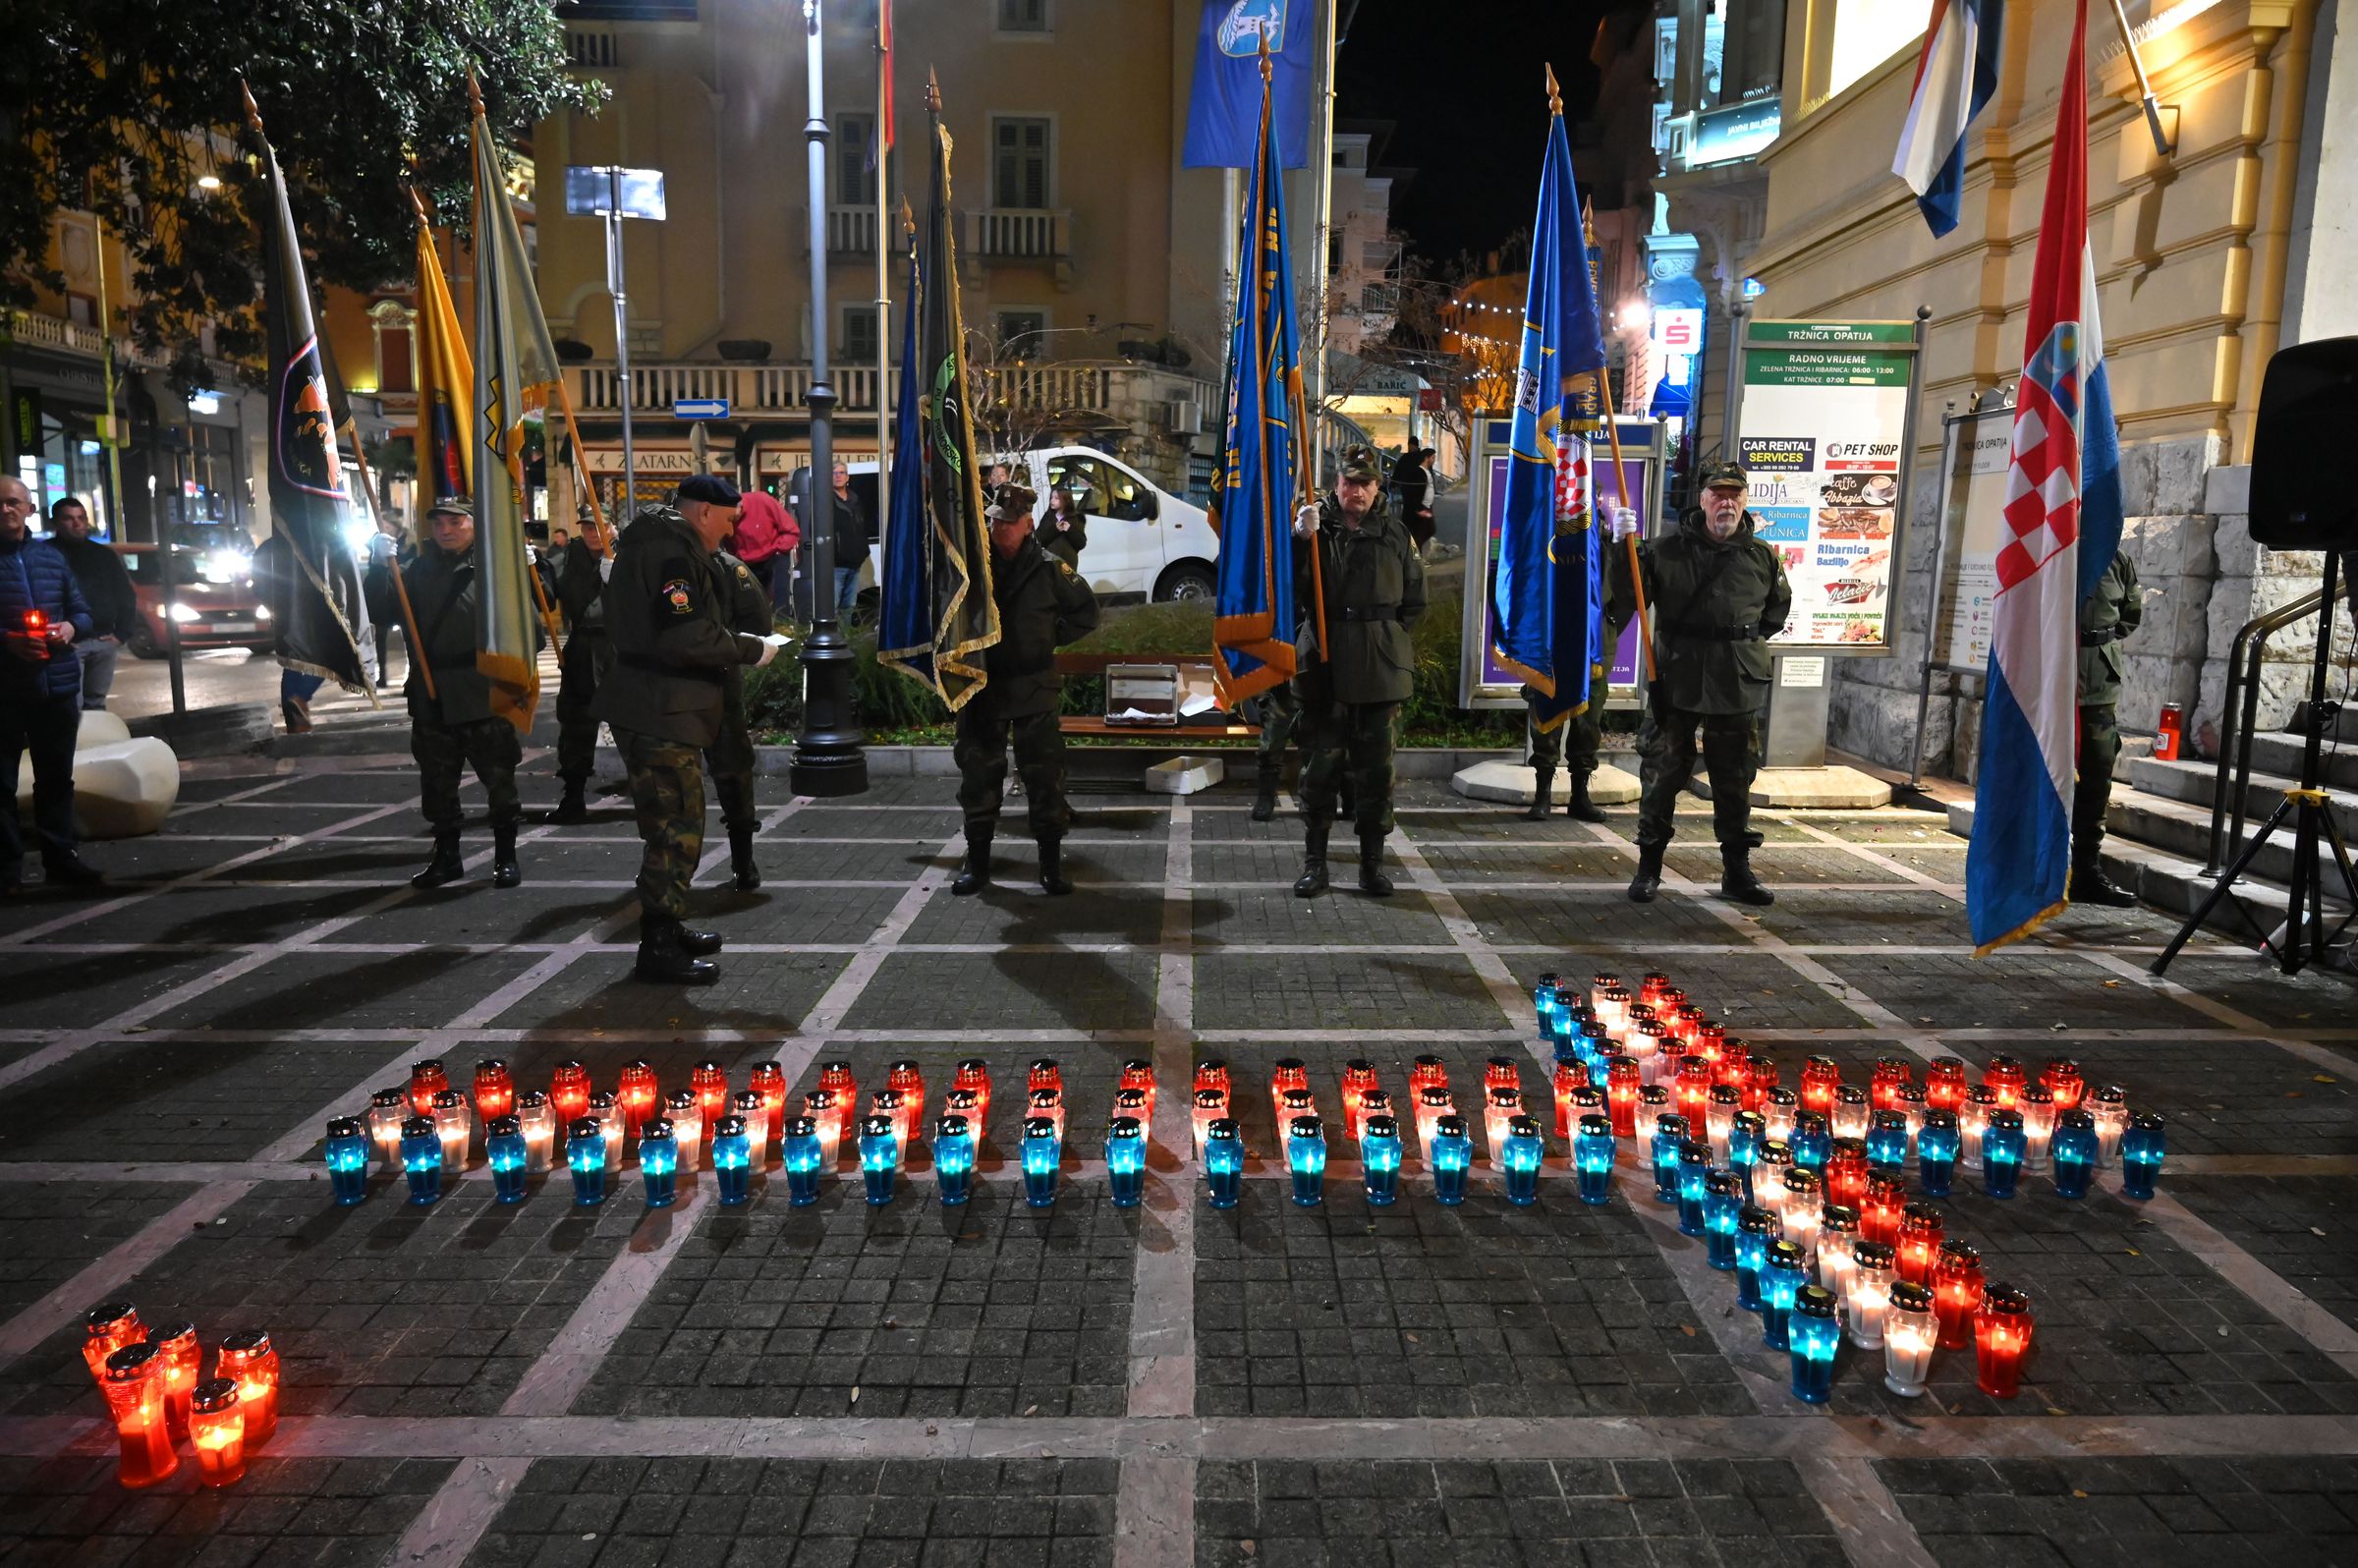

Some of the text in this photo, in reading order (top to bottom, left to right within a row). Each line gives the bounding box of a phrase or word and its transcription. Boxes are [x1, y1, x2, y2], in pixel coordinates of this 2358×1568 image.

[1788, 329, 1873, 341] TRŽNICA OPATIJA
[1789, 355, 1867, 364] RADNO VRIJEME
[1742, 440, 1812, 451] CAR RENTAL
[1843, 444, 1898, 456] PET SHOP
[1749, 453, 1804, 463] SERVICES
[1747, 482, 1787, 506] LIDIJA
[1824, 489, 1864, 506] Abbazia
[1768, 510, 1808, 519] Ribarnica
[1763, 527, 1805, 537] TUNICA
[1817, 543, 1870, 554] Ribarnica
